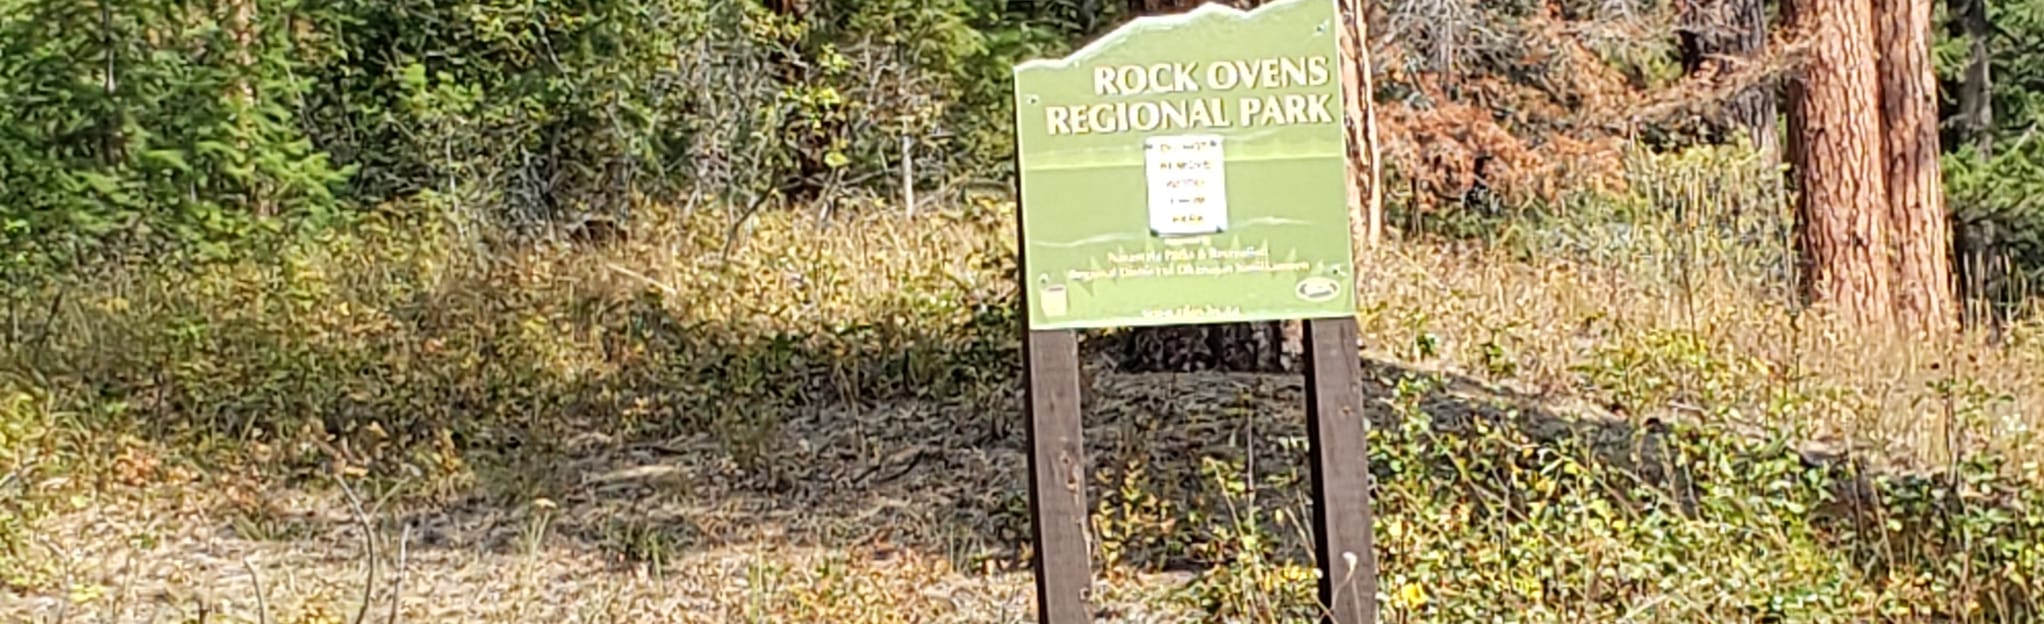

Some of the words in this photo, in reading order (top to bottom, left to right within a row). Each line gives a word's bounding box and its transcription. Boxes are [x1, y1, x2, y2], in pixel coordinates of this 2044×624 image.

[1093, 62, 1199, 96] ROCK
[1206, 56, 1330, 91] OVENS
[1045, 97, 1232, 136] REGIONAL
[1239, 94, 1335, 127] PARK
